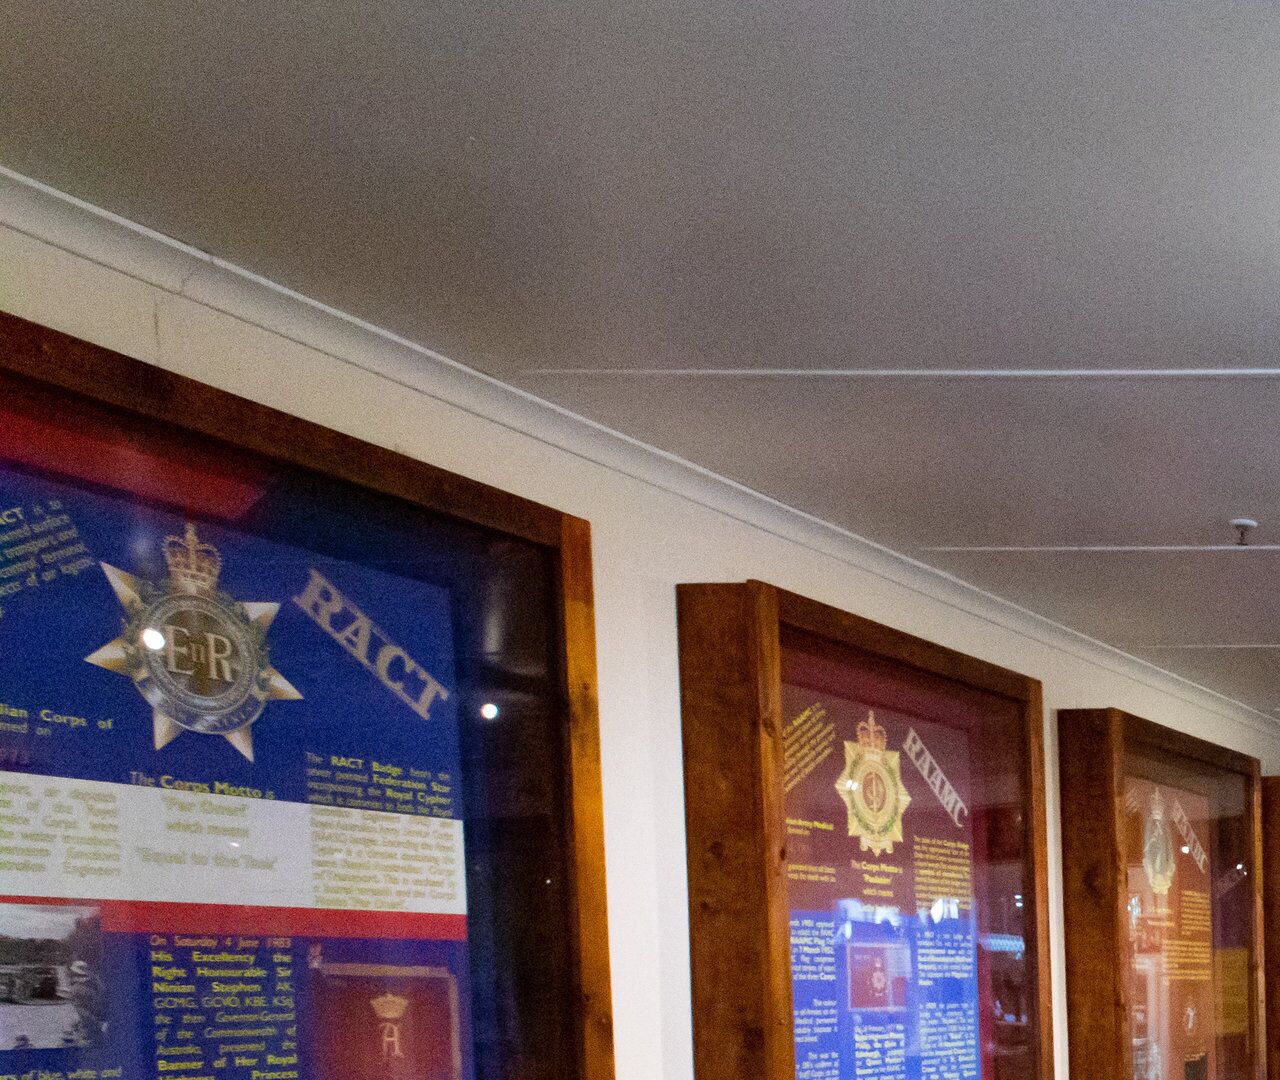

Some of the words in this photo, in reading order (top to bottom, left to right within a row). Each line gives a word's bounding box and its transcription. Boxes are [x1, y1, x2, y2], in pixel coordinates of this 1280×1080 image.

[292, 568, 448, 720] RACT
[40, 709, 87, 728] Corps
[331, 755, 363, 769] RACT
[130, 770, 155, 788] The
[160, 775, 211, 794] Corps
[214, 781, 262, 798] Motto
[151, 951, 173, 962] His
[193, 951, 255, 964] Excellency
[273, 953, 291, 962] the
[152, 966, 187, 980] Right
[197, 967, 267, 978] Honourable
[277, 967, 292, 977] Sir
[153, 982, 195, 993] Ninian
[212, 981, 261, 995] Stephen
[158, 1059, 204, 1071] Banner
[235, 1056, 258, 1067] Her
[266, 1053, 298, 1067] Royal
[251, 1069, 298, 1080] Princess
